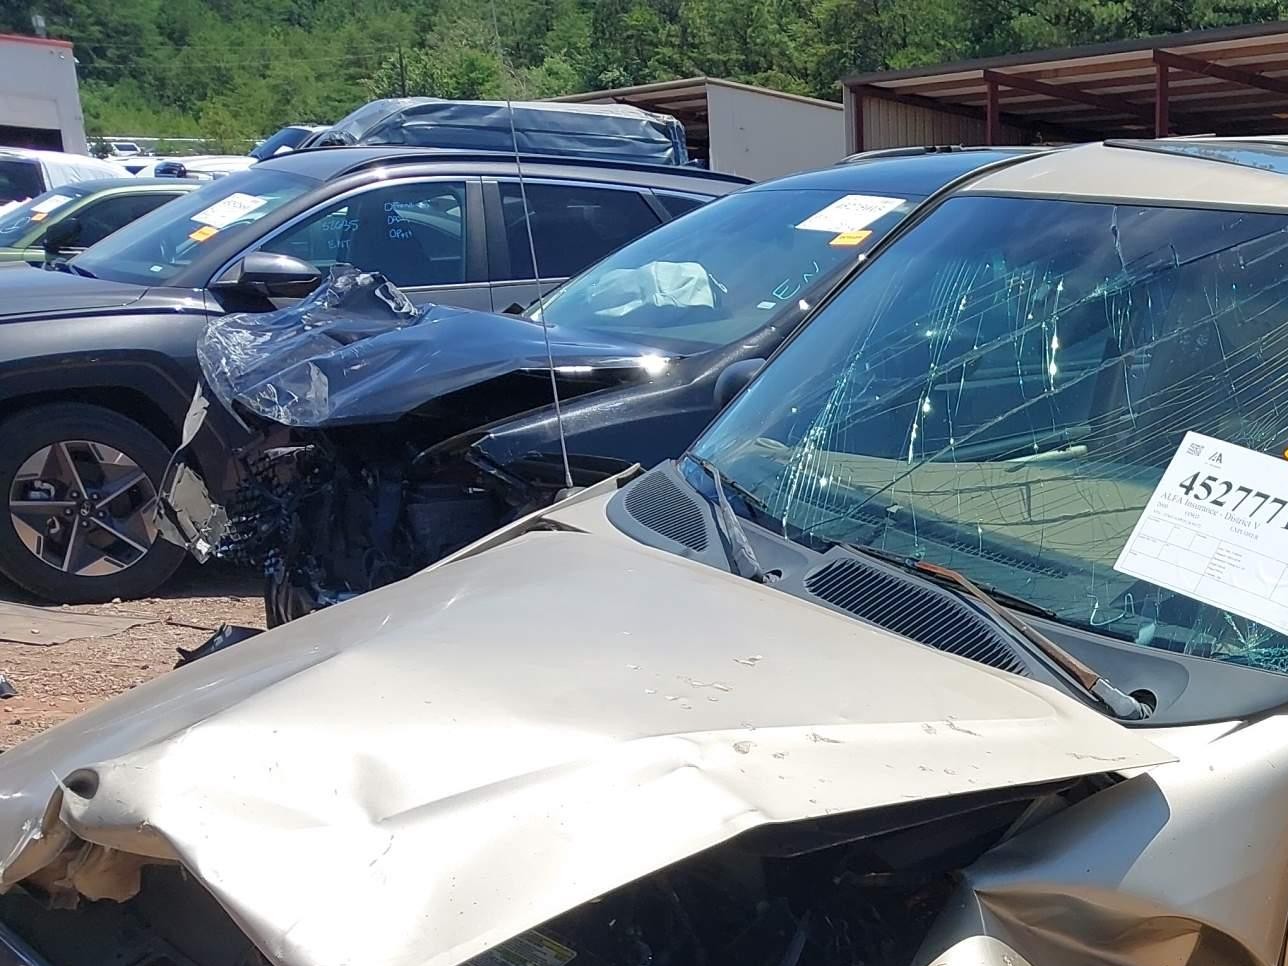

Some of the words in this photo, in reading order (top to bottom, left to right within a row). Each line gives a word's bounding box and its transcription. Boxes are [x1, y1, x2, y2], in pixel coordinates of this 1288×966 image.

[1160, 491, 1183, 505] ALFA
[1184, 498, 1219, 517] Insurance
[1224, 511, 1252, 528] District
